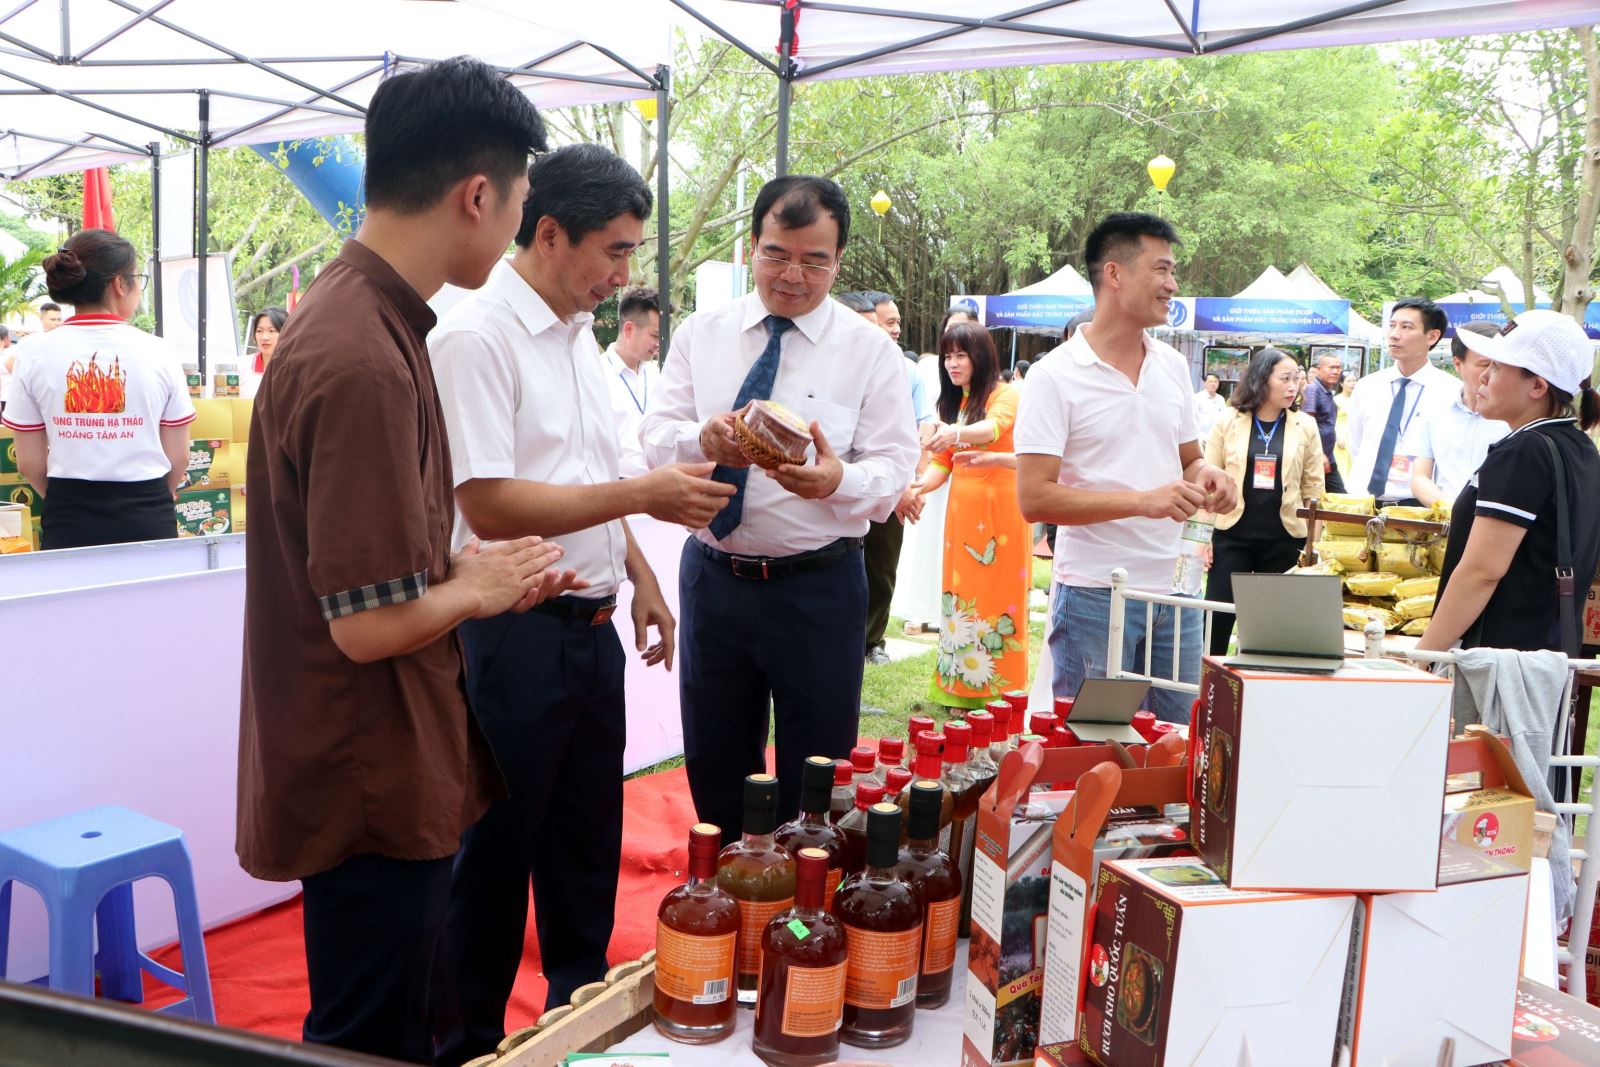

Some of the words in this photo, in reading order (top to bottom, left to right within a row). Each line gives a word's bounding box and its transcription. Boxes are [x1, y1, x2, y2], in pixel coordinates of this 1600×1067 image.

[107, 418, 119, 428] HẠ
[120, 431, 134, 439] AN
[1201, 773, 1209, 808] KHO
[1113, 893, 1129, 938] TUẤN
[1108, 939, 1122, 984] QUỐC
[1104, 985, 1117, 1022] KHO
